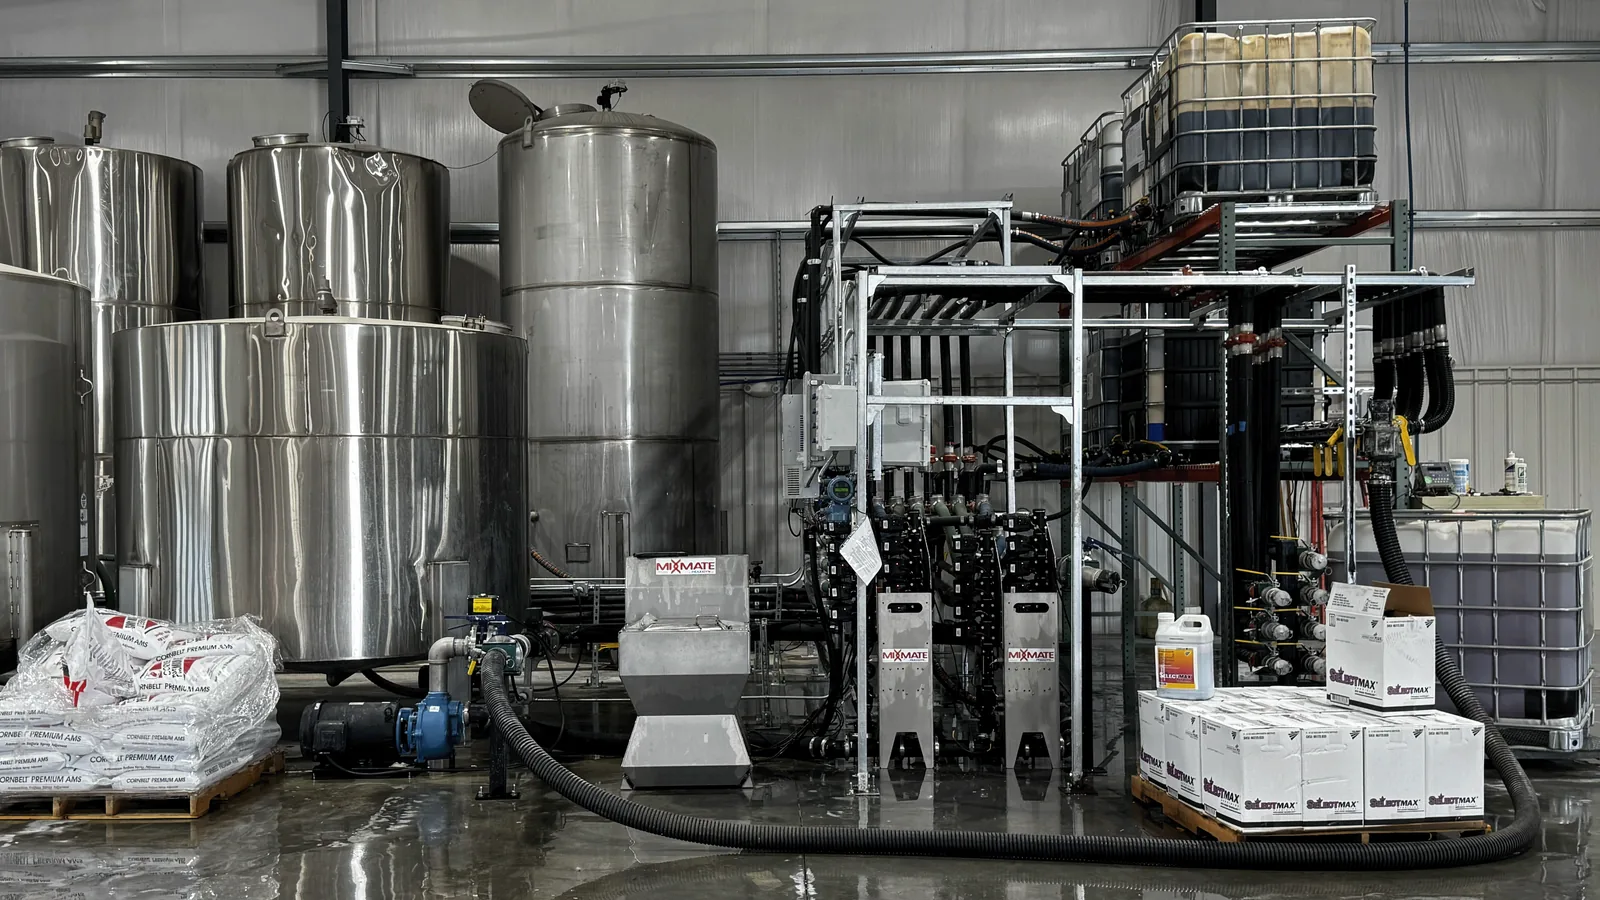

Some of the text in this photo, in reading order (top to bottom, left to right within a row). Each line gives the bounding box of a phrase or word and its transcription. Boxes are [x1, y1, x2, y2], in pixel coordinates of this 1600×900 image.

[656, 559, 715, 574] MIXMATE
[134, 638, 149, 648] AMS
[156, 649, 185, 662] CORNBELT
[187, 644, 217, 653] PREMIUM
[882, 650, 928, 661] MIXMATE
[1008, 649, 1054, 661] MIXMATE
[140, 682, 162, 690] RNBELT
[29, 731, 64, 741] PREMIUM
[64, 734, 82, 742] AMS
[124, 753, 157, 761] PREMIUM
[157, 754, 175, 762] AMS
[0, 775, 82, 784] ORNBELT PREMIUM AMS
